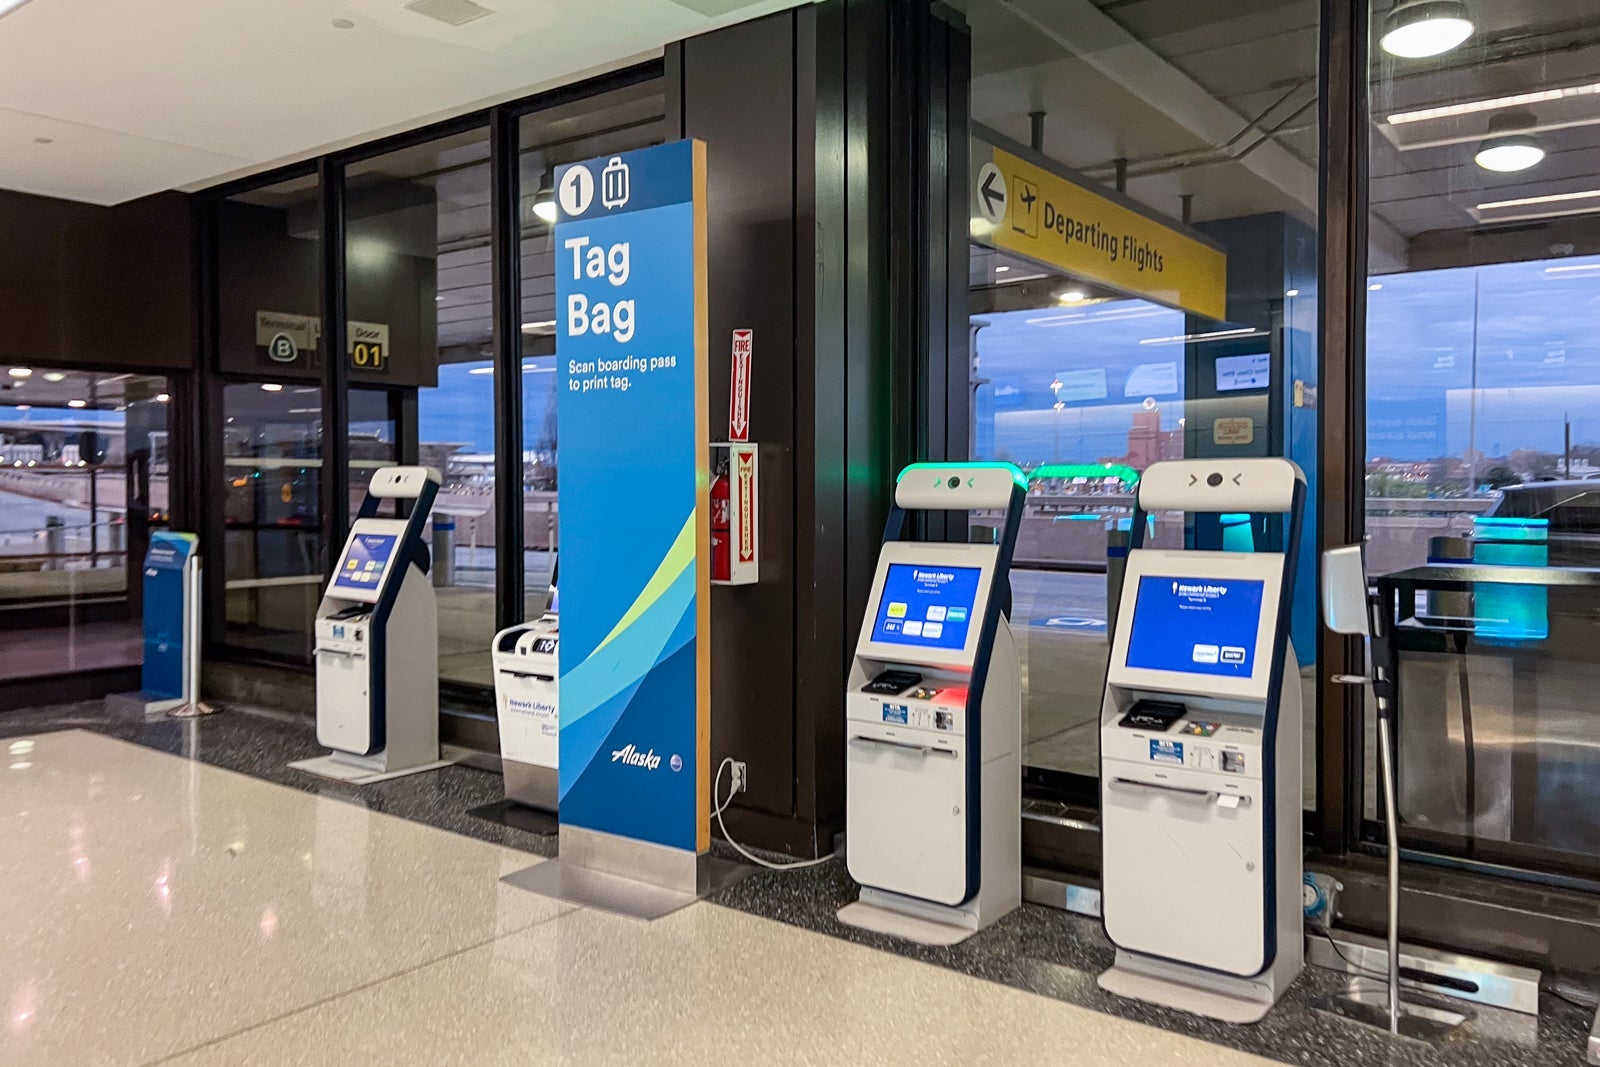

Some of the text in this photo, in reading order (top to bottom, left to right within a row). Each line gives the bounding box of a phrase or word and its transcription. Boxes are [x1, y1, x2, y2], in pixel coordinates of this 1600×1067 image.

[1043, 201, 1164, 273] Departing Flights
[564, 235, 630, 287] Tag
[567, 293, 635, 343] Bag
[355, 327, 380, 339] Door
[277, 340, 290, 357] B
[734, 339, 750, 352] FIRE
[354, 343, 380, 367] 01
[568, 354, 677, 373] Scan boarding pass
[568, 374, 632, 392] to print tag.
[1178, 583, 1228, 596] Newark Liberty
[509, 698, 556, 715] Newark Liberty
[611, 743, 662, 771] Alaska
